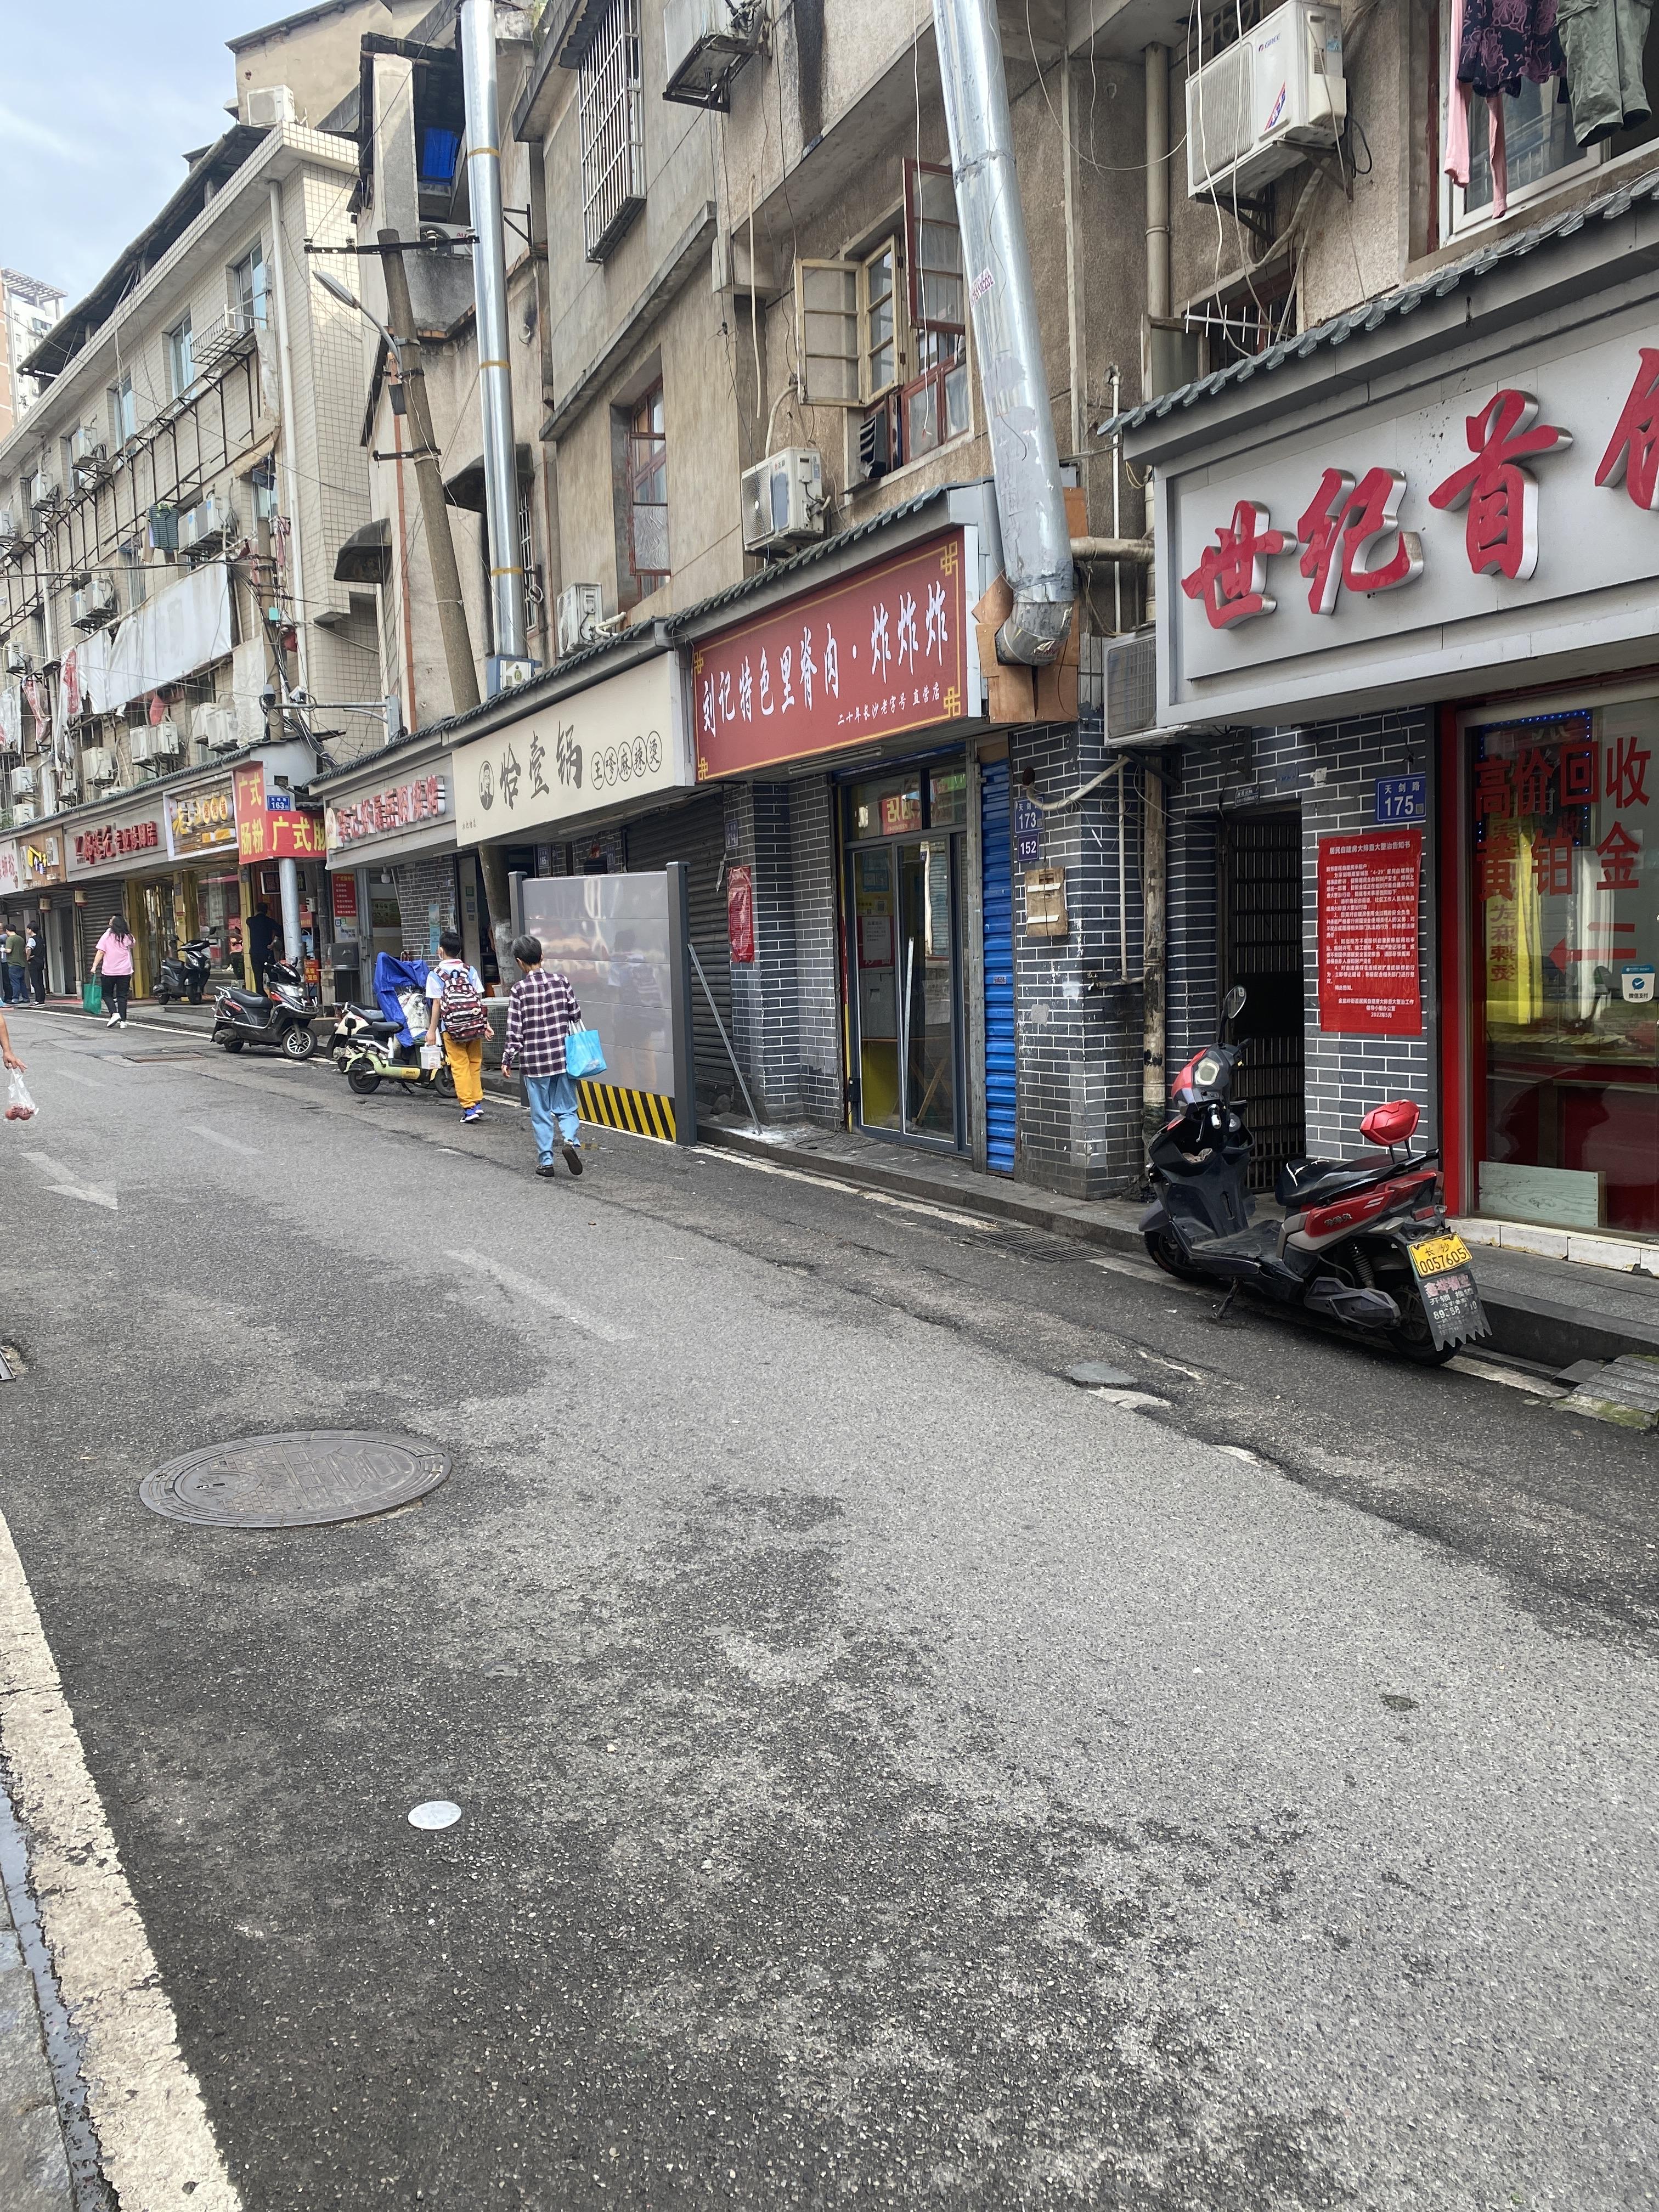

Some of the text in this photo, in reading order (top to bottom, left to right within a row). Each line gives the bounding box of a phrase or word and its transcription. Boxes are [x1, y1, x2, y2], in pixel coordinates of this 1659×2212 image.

[837, 682, 941, 726] 二十年长沙老字号 直营店
[1384, 781, 1420, 794] 天剑路
[1475, 736, 1651, 821] 高价回收
[238, 771, 262, 811] 广式
[1385, 795, 1414, 816] 175
[1019, 812, 1036, 830] 173
[240, 817, 264, 856] 肠粉
[1020, 840, 1037, 855] 152
[1419, 1247, 1468, 1273] 0057605
[1425, 1243, 1450, 1257] 长沙
[1429, 1294, 1451, 1306] 开锁
